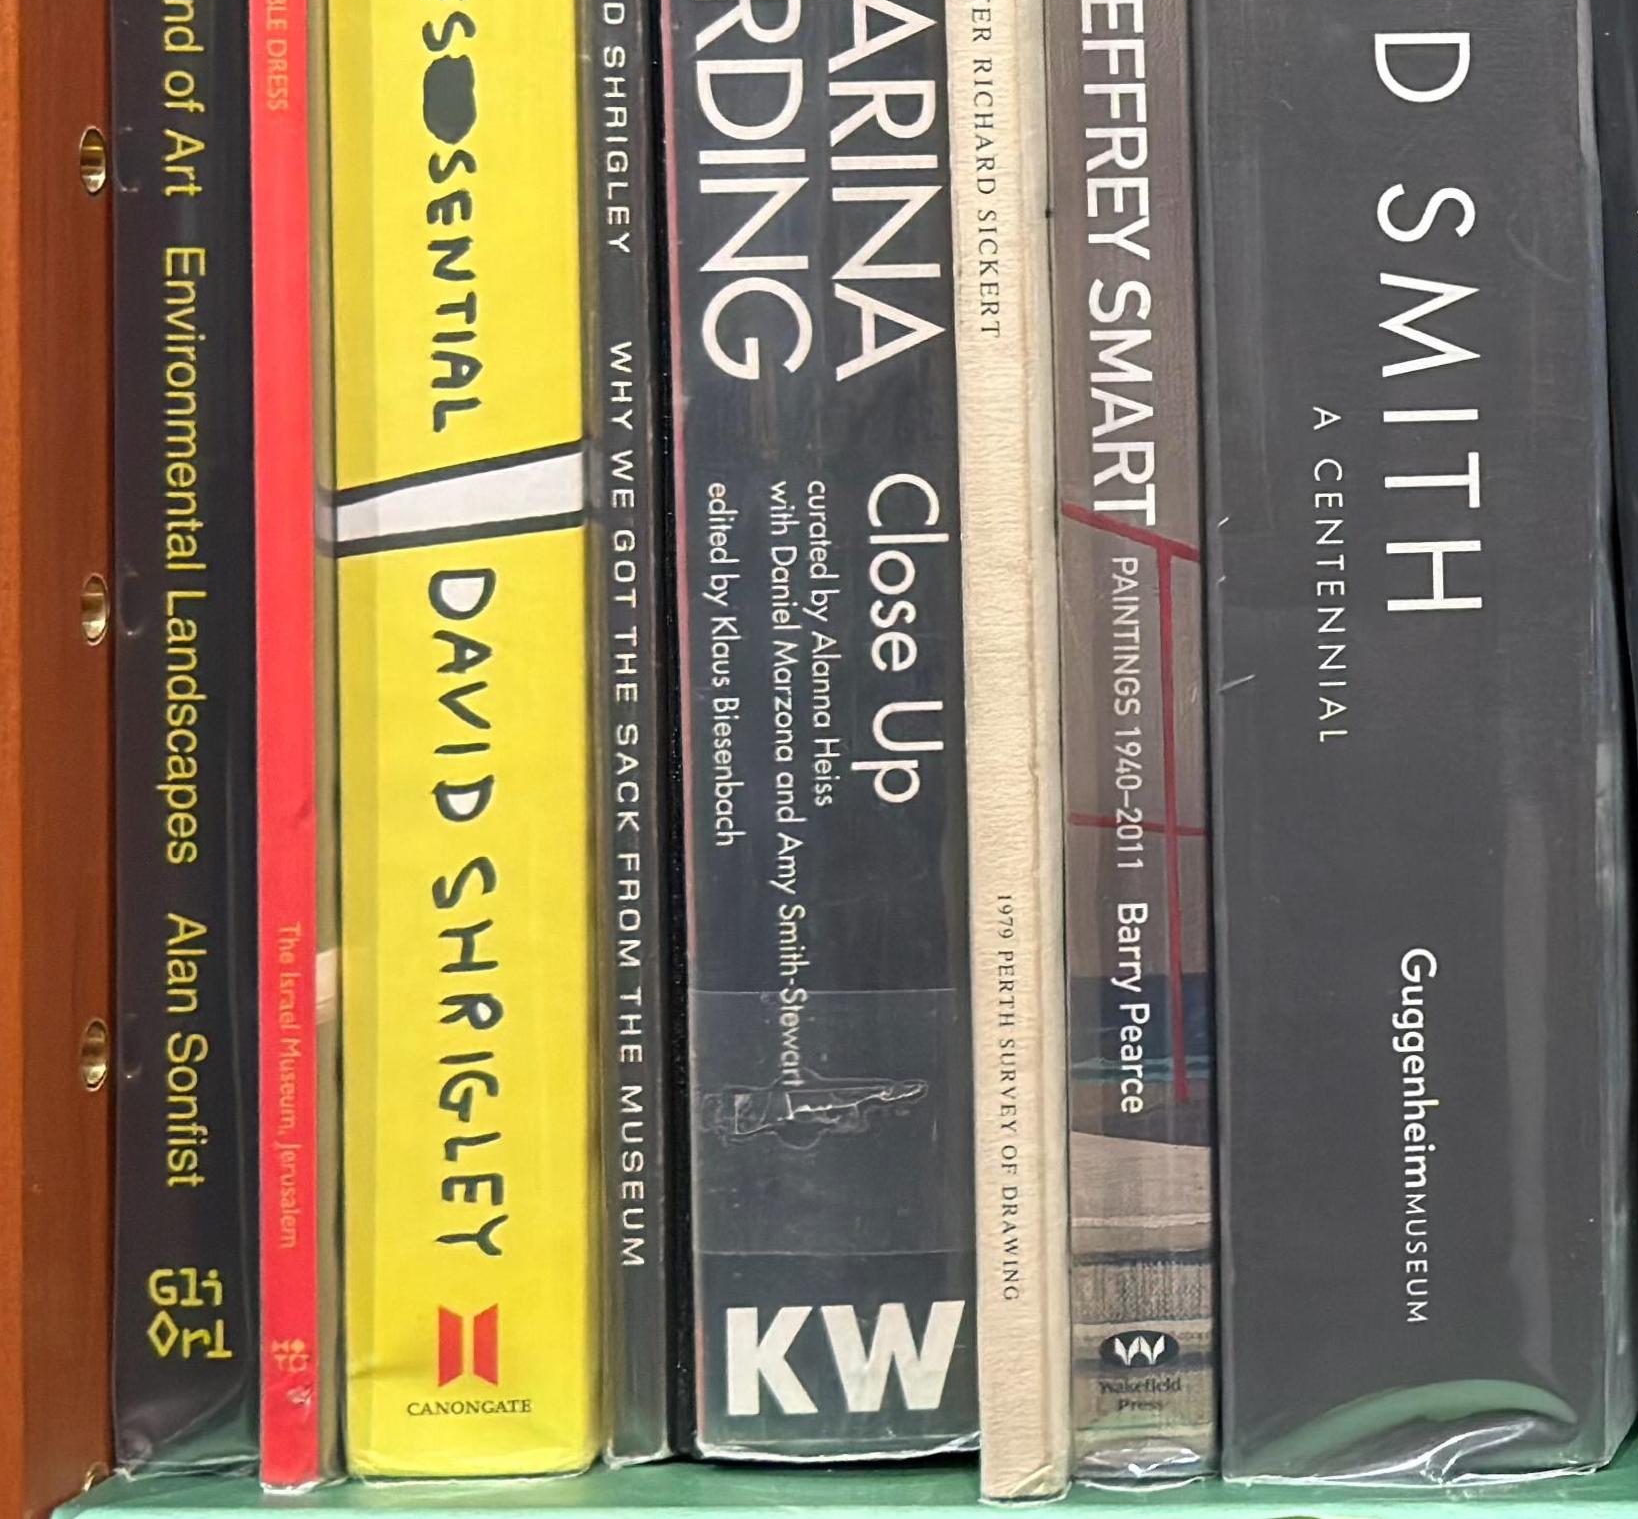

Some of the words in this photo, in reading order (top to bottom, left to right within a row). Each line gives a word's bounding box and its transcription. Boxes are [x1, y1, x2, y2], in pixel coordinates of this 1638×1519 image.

[164, 71, 204, 112] of
[267, 40, 288, 110] DRESS
[973, 59, 995, 194] RICHARD
[165, 129, 204, 196] Art
[978, 210, 1000, 334] SICKERT
[165, 248, 206, 569] Environmental
[1089, 279, 1155, 525] SMART
[1377, 184, 1482, 611] SMITH
[868, 474, 949, 671] Close
[1112, 558, 1140, 715] PAINTINGS
[156, 591, 206, 863] Landscapes
[428, 569, 495, 822] DAVID
[851, 701, 943, 802] Up
[167, 913, 207, 1012] Alan
[280, 921, 301, 963] The
[1111, 903, 1148, 992] Barry
[279, 973, 301, 1029] Israel
[432, 857, 508, 1256] SHRIGLEY
[167, 1033, 208, 1186] Sonfist
[279, 1039, 301, 1134] Museum,
[1120, 1004, 1149, 1113] Pearce
[275, 1142, 302, 1247] Jerusalem
[406, 1399, 533, 1415] CANONGATE
[727, 1301, 965, 1417] KW
